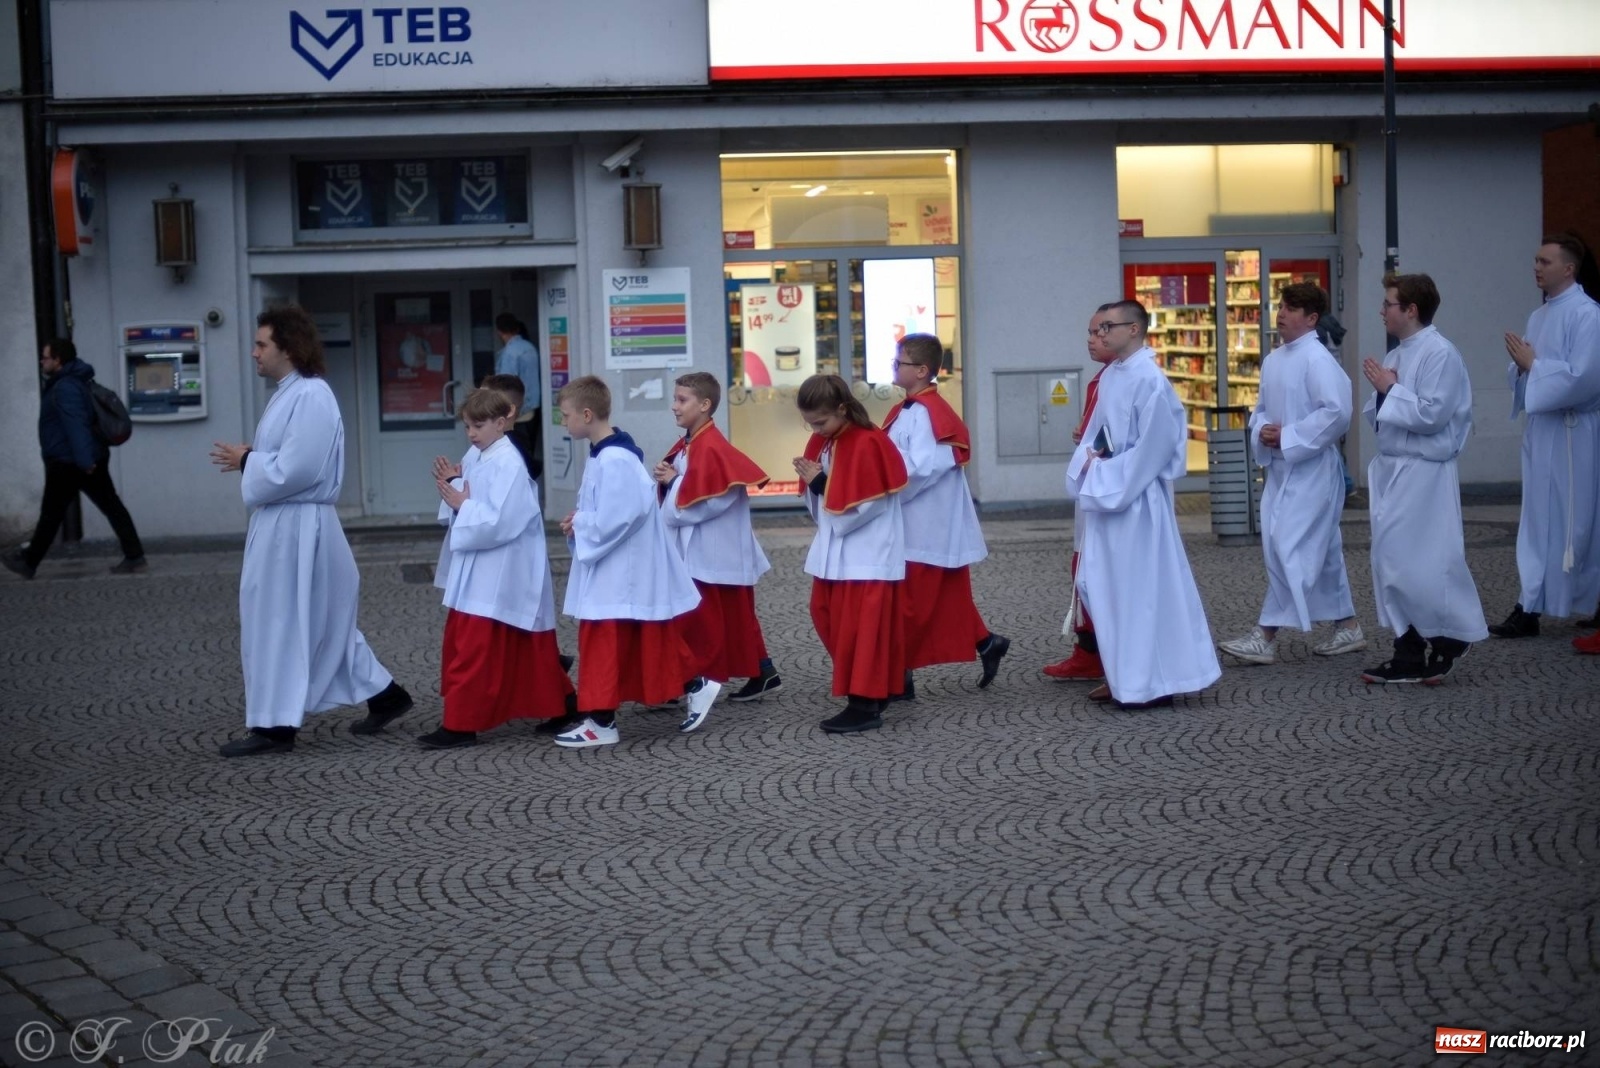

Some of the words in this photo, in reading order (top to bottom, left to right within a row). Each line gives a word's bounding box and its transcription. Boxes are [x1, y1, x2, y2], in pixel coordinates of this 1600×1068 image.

[372, 7, 472, 44] TEB
[974, 0, 1406, 53] ROSSMANN
[373, 51, 473, 67] EDUKACJA
[324, 163, 361, 179] TEB
[394, 163, 428, 177] TEB
[461, 161, 496, 176] TEB
[628, 275, 649, 284] TEB
